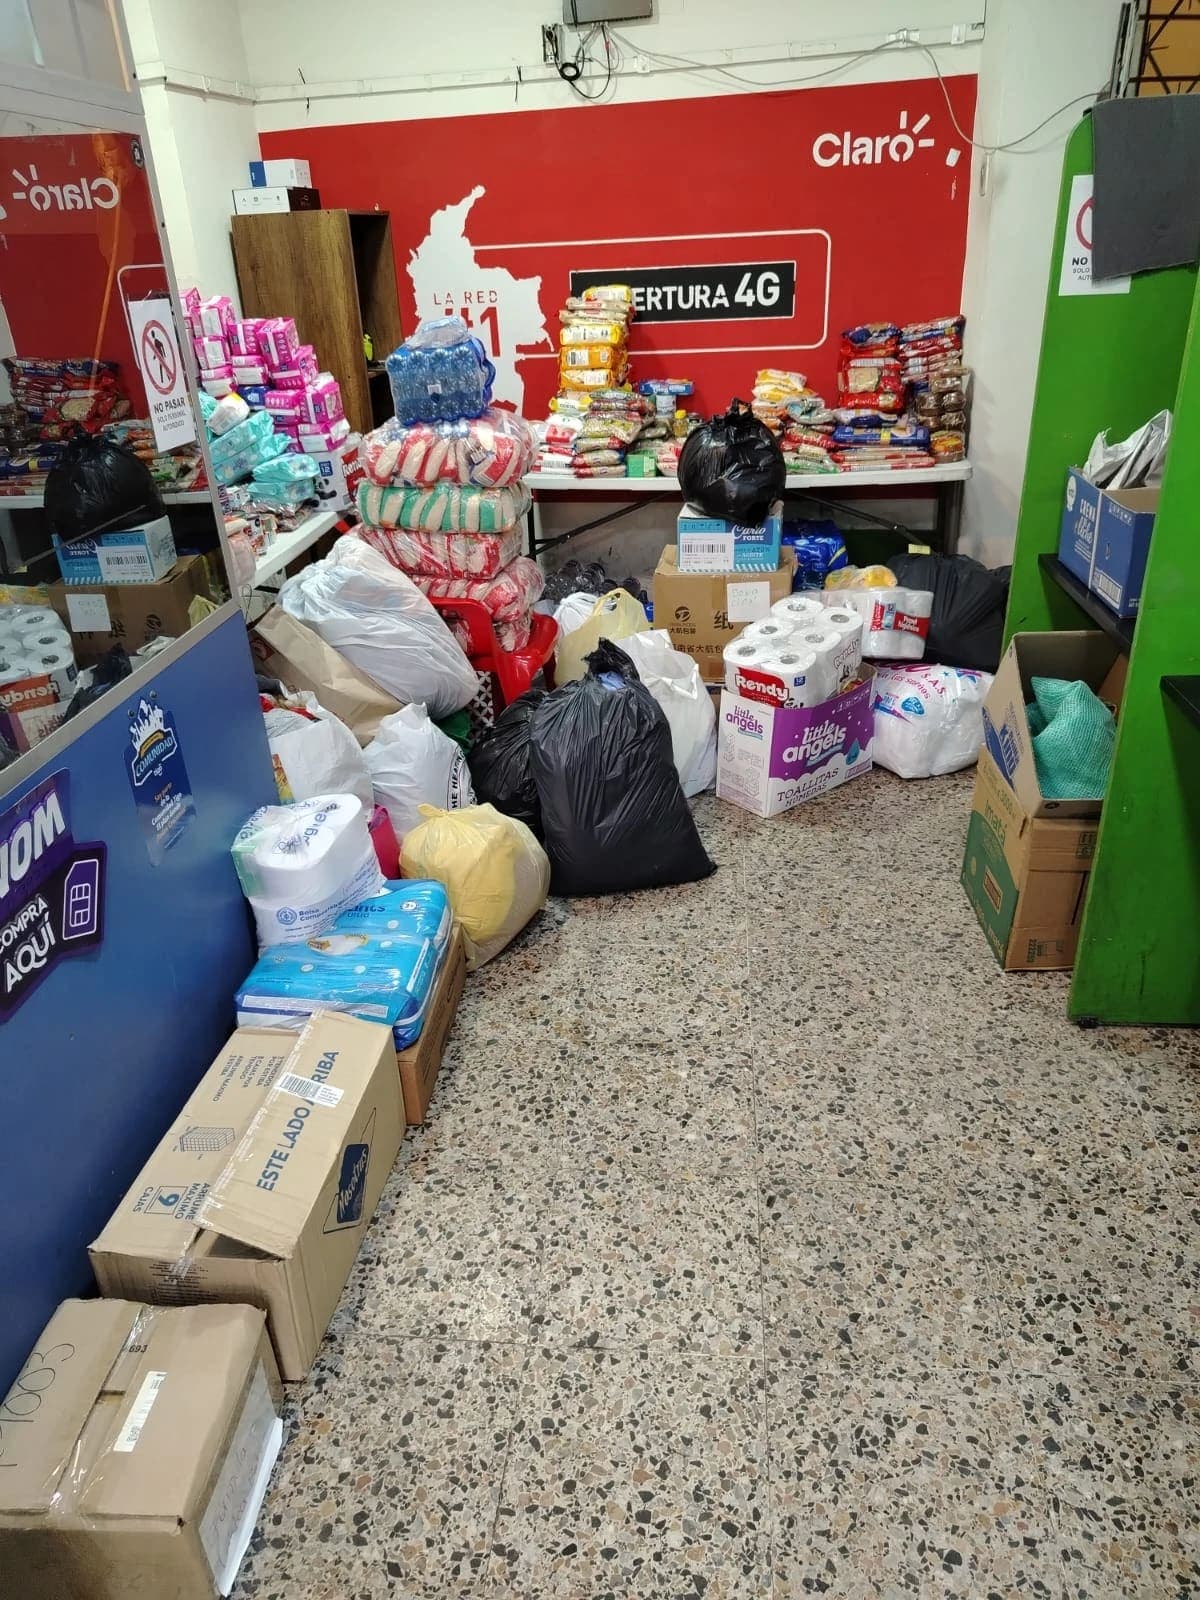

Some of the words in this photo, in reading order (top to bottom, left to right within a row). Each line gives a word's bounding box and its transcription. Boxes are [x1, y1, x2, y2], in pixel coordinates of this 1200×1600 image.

[812, 131, 914, 168] Claro
[1072, 257, 1088, 266] NO
[433, 291, 455, 305] LA
[464, 290, 499, 304] RED
[632, 285, 731, 311] ERTURA
[733, 271, 781, 307] 4G
[154, 403, 164, 414] NO
[164, 397, 186, 411] PASAR
[735, 674, 790, 701] Rendy
[726, 711, 764, 734] angels
[734, 705, 755, 721] little
[782, 724, 847, 764] angels
[802, 719, 836, 745] little
[135, 737, 174, 777] COMUNIDAD
[777, 767, 839, 802] TOALLITAS
[5, 911, 56, 993] AQUÍ
[256, 1150, 290, 1192] ESTE
[280, 1105, 311, 1150] LADO
[132, 1186, 154, 1213] CAJAS
